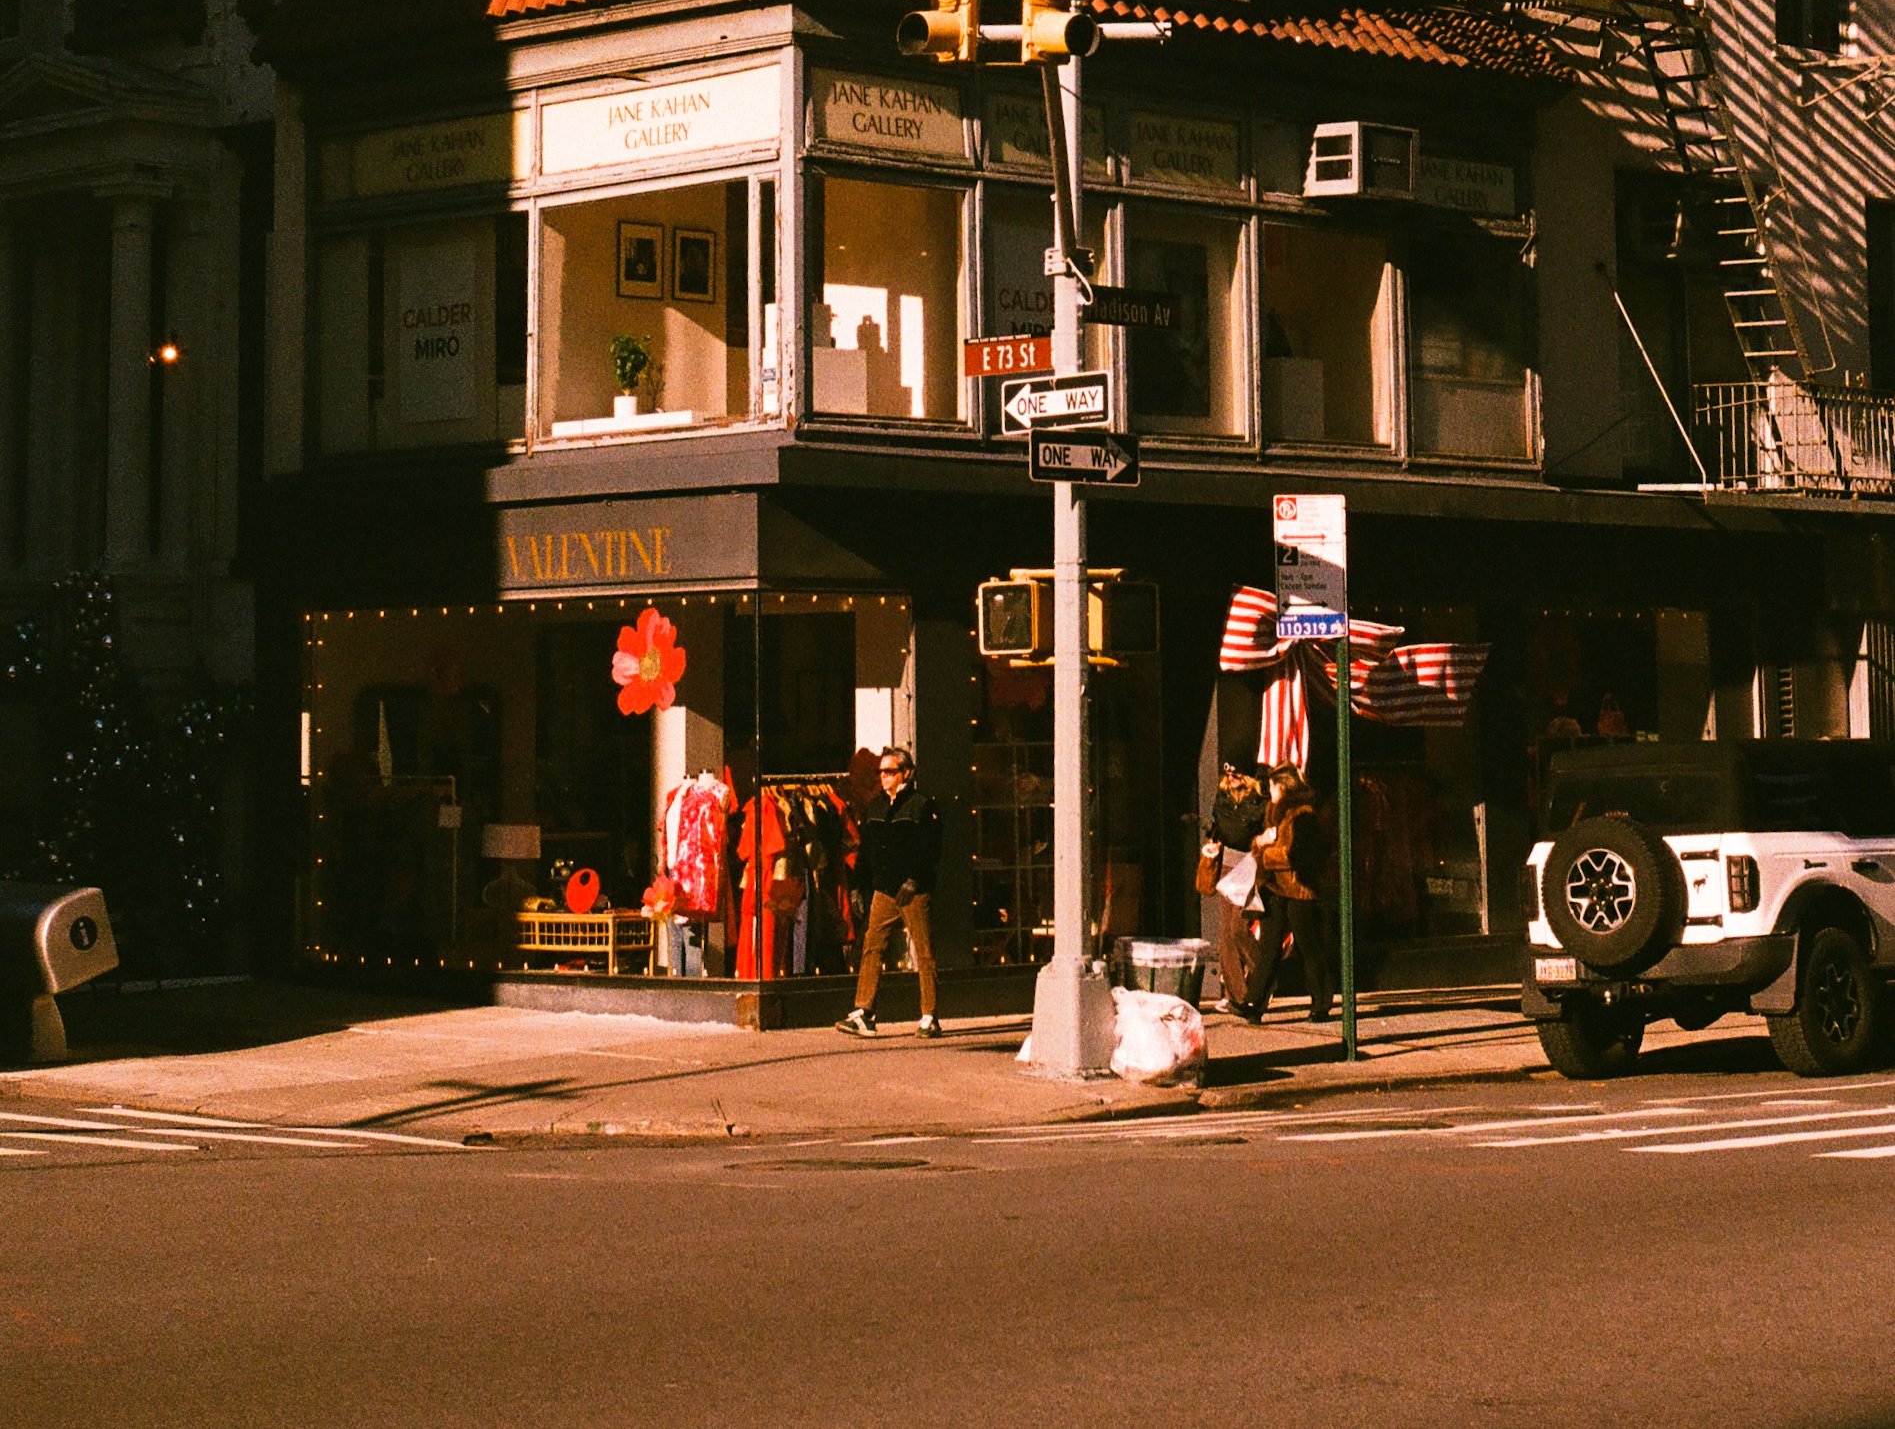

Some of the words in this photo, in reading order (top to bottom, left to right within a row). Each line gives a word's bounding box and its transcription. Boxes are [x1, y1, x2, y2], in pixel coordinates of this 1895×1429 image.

[608, 101, 643, 129] JANE
[651, 91, 710, 119] KAHAN
[832, 82, 872, 106] JANE
[880, 88, 941, 114] KAHAN
[624, 121, 691, 150] GALLERY
[852, 112, 923, 139] GALLERY
[1136, 121, 1170, 144] JANE
[1177, 126, 1233, 150] KAHAN
[393, 136, 424, 160] JANE
[430, 129, 485, 152] KAHAN
[406, 154, 465, 182] GALLERY
[1153, 149, 1215, 175] GALLERY
[999, 288, 1054, 313] CALD
[404, 302, 472, 328] CALDER
[1154, 303, 1170, 326] Av
[414, 331, 460, 360] MIRÓ
[982, 346, 991, 370] E
[997, 344, 1013, 369] 73
[1020, 342, 1036, 368] St
[1017, 396, 1048, 416] ONE
[1065, 389, 1098, 411] WAY
[1042, 445, 1071, 466] ONE
[1091, 447, 1121, 469] WAY
[507, 527, 671, 580] VALENTINE
[1282, 546, 1293, 564] 2
[1280, 622, 1327, 635] 110319
